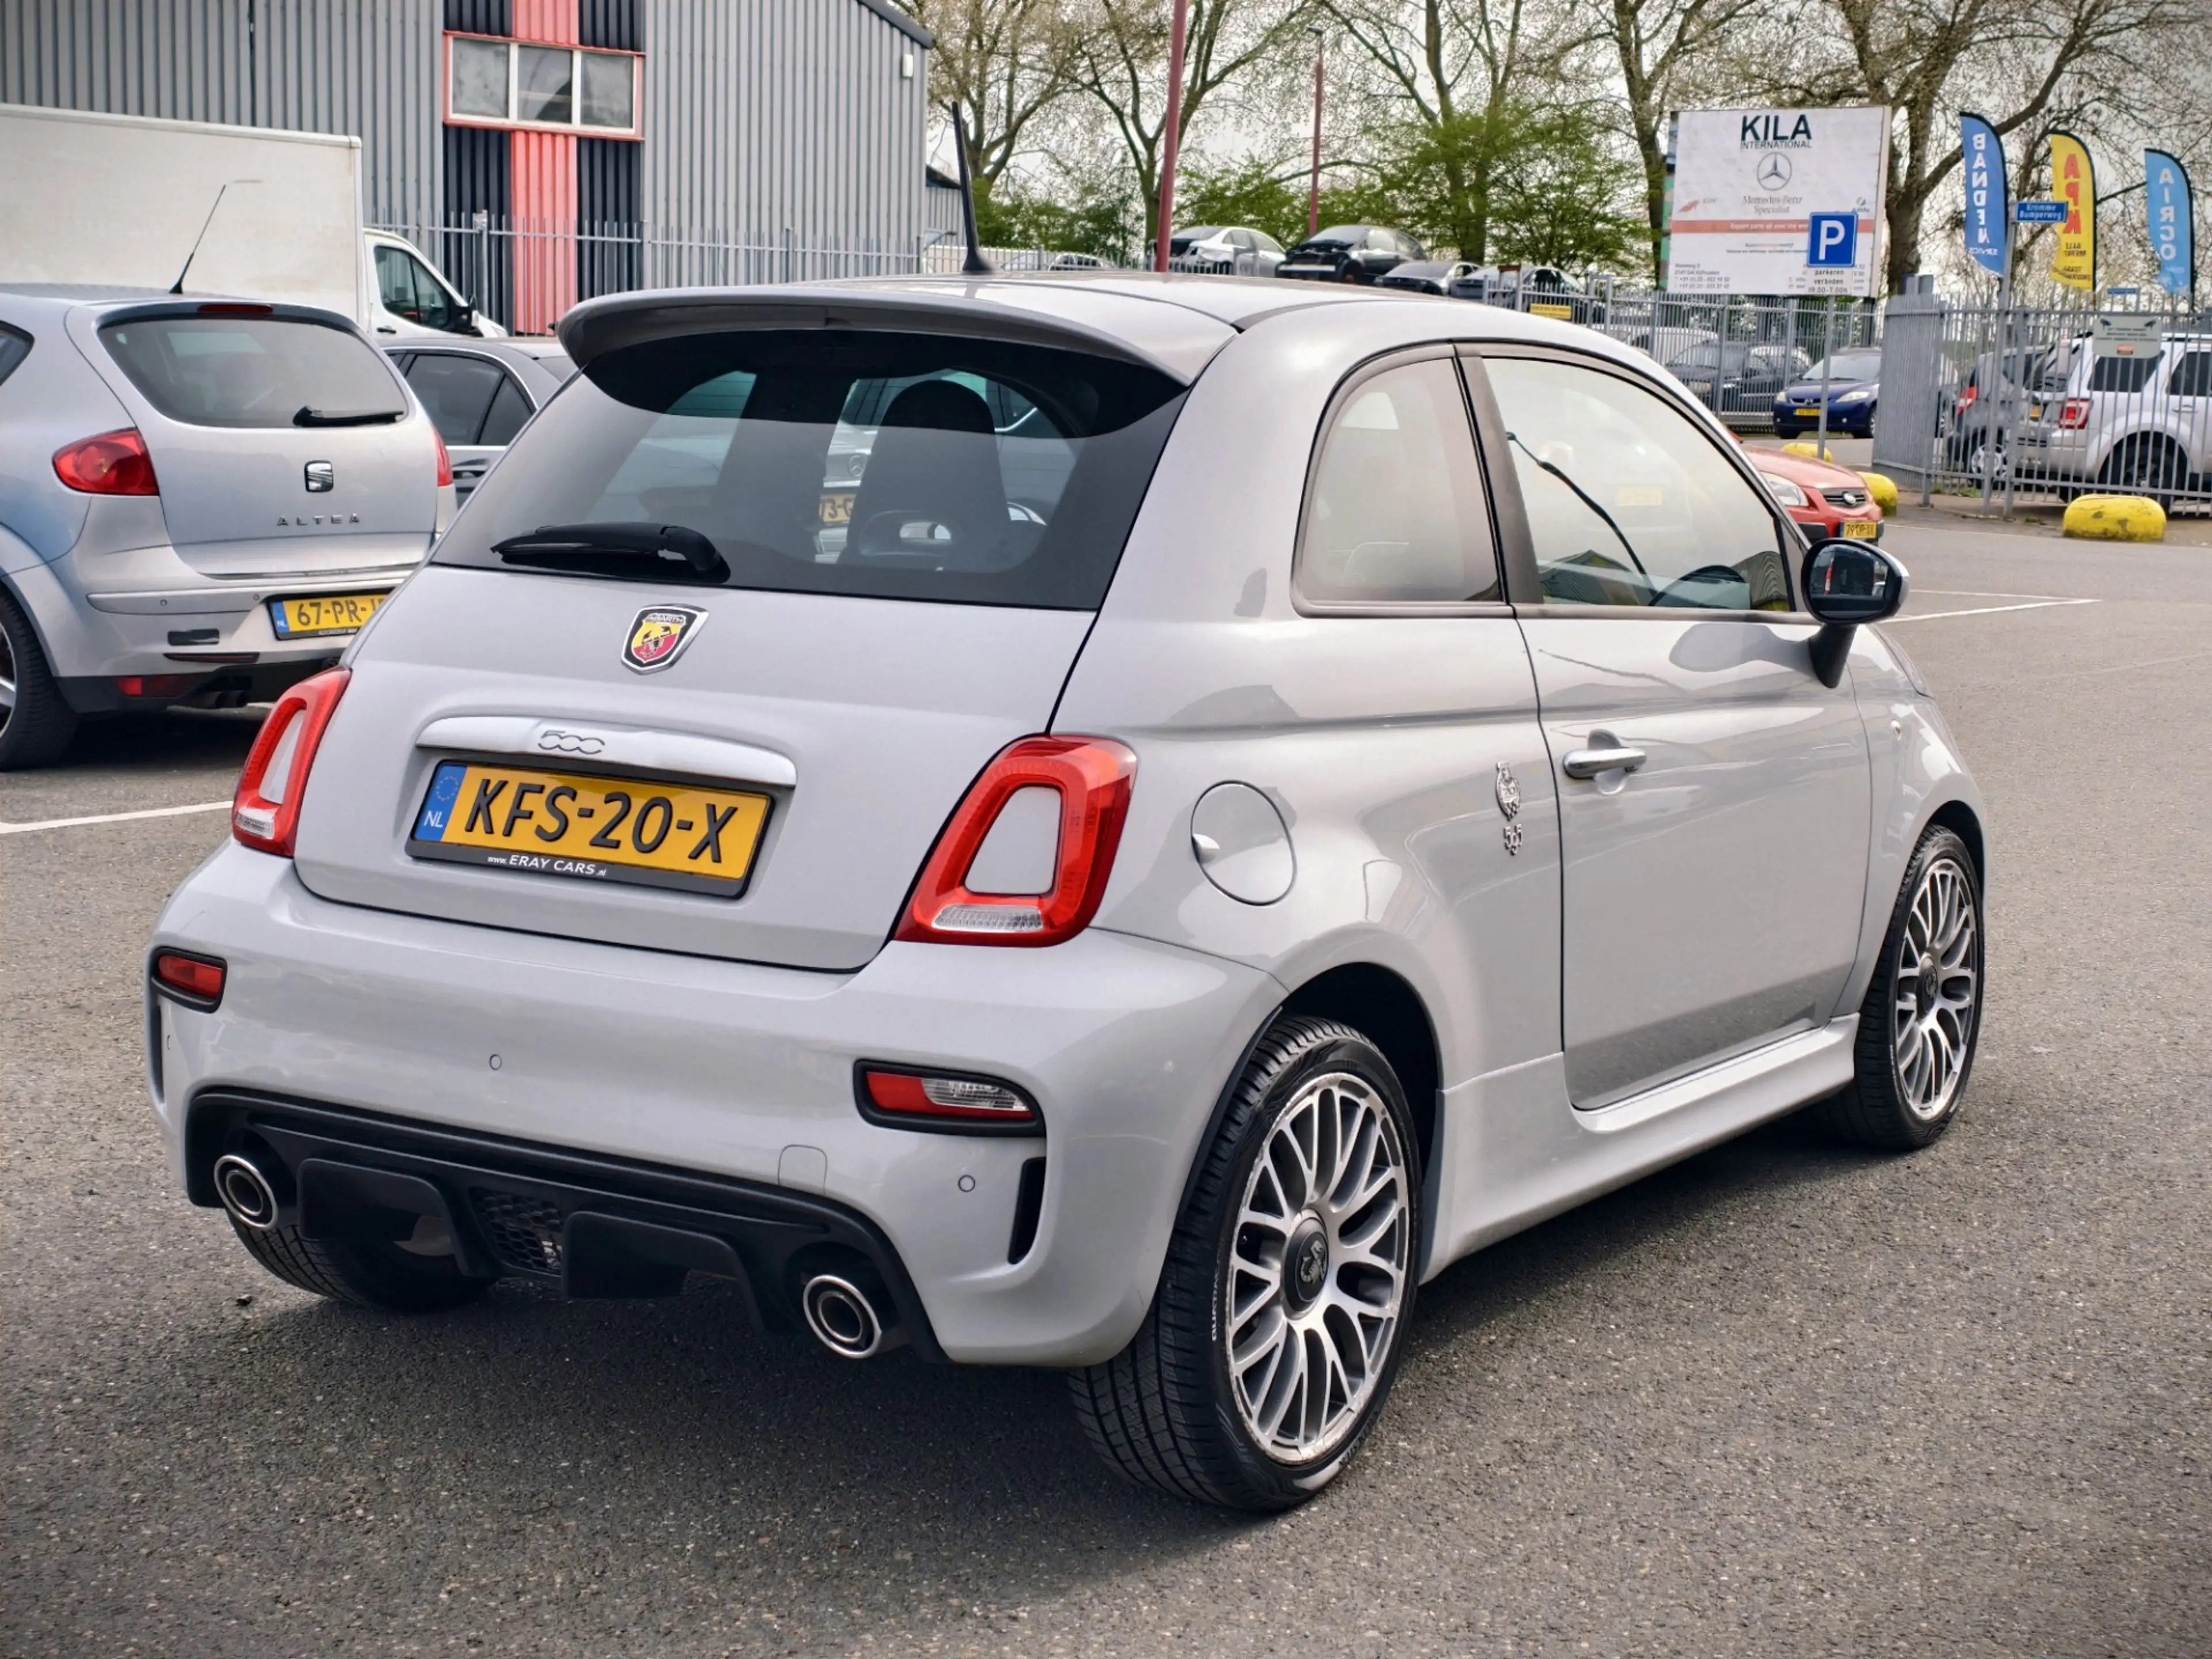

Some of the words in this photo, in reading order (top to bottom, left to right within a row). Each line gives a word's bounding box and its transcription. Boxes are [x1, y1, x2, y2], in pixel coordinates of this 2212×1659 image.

[1741, 114, 1812, 141] KILA
[1740, 139, 1812, 149] INTERNATIONAL
[2019, 210, 2062, 220] Bumperweg
[1818, 219, 1846, 260] P
[1814, 276, 1844, 285] verboden
[276, 513, 360, 527] ALTEA
[296, 598, 385, 626] 67-PR-
[423, 810, 444, 828] NL
[464, 778, 739, 863] KFS-20-X
[509, 854, 551, 869] ERAY
[554, 860, 596, 875] CARS
